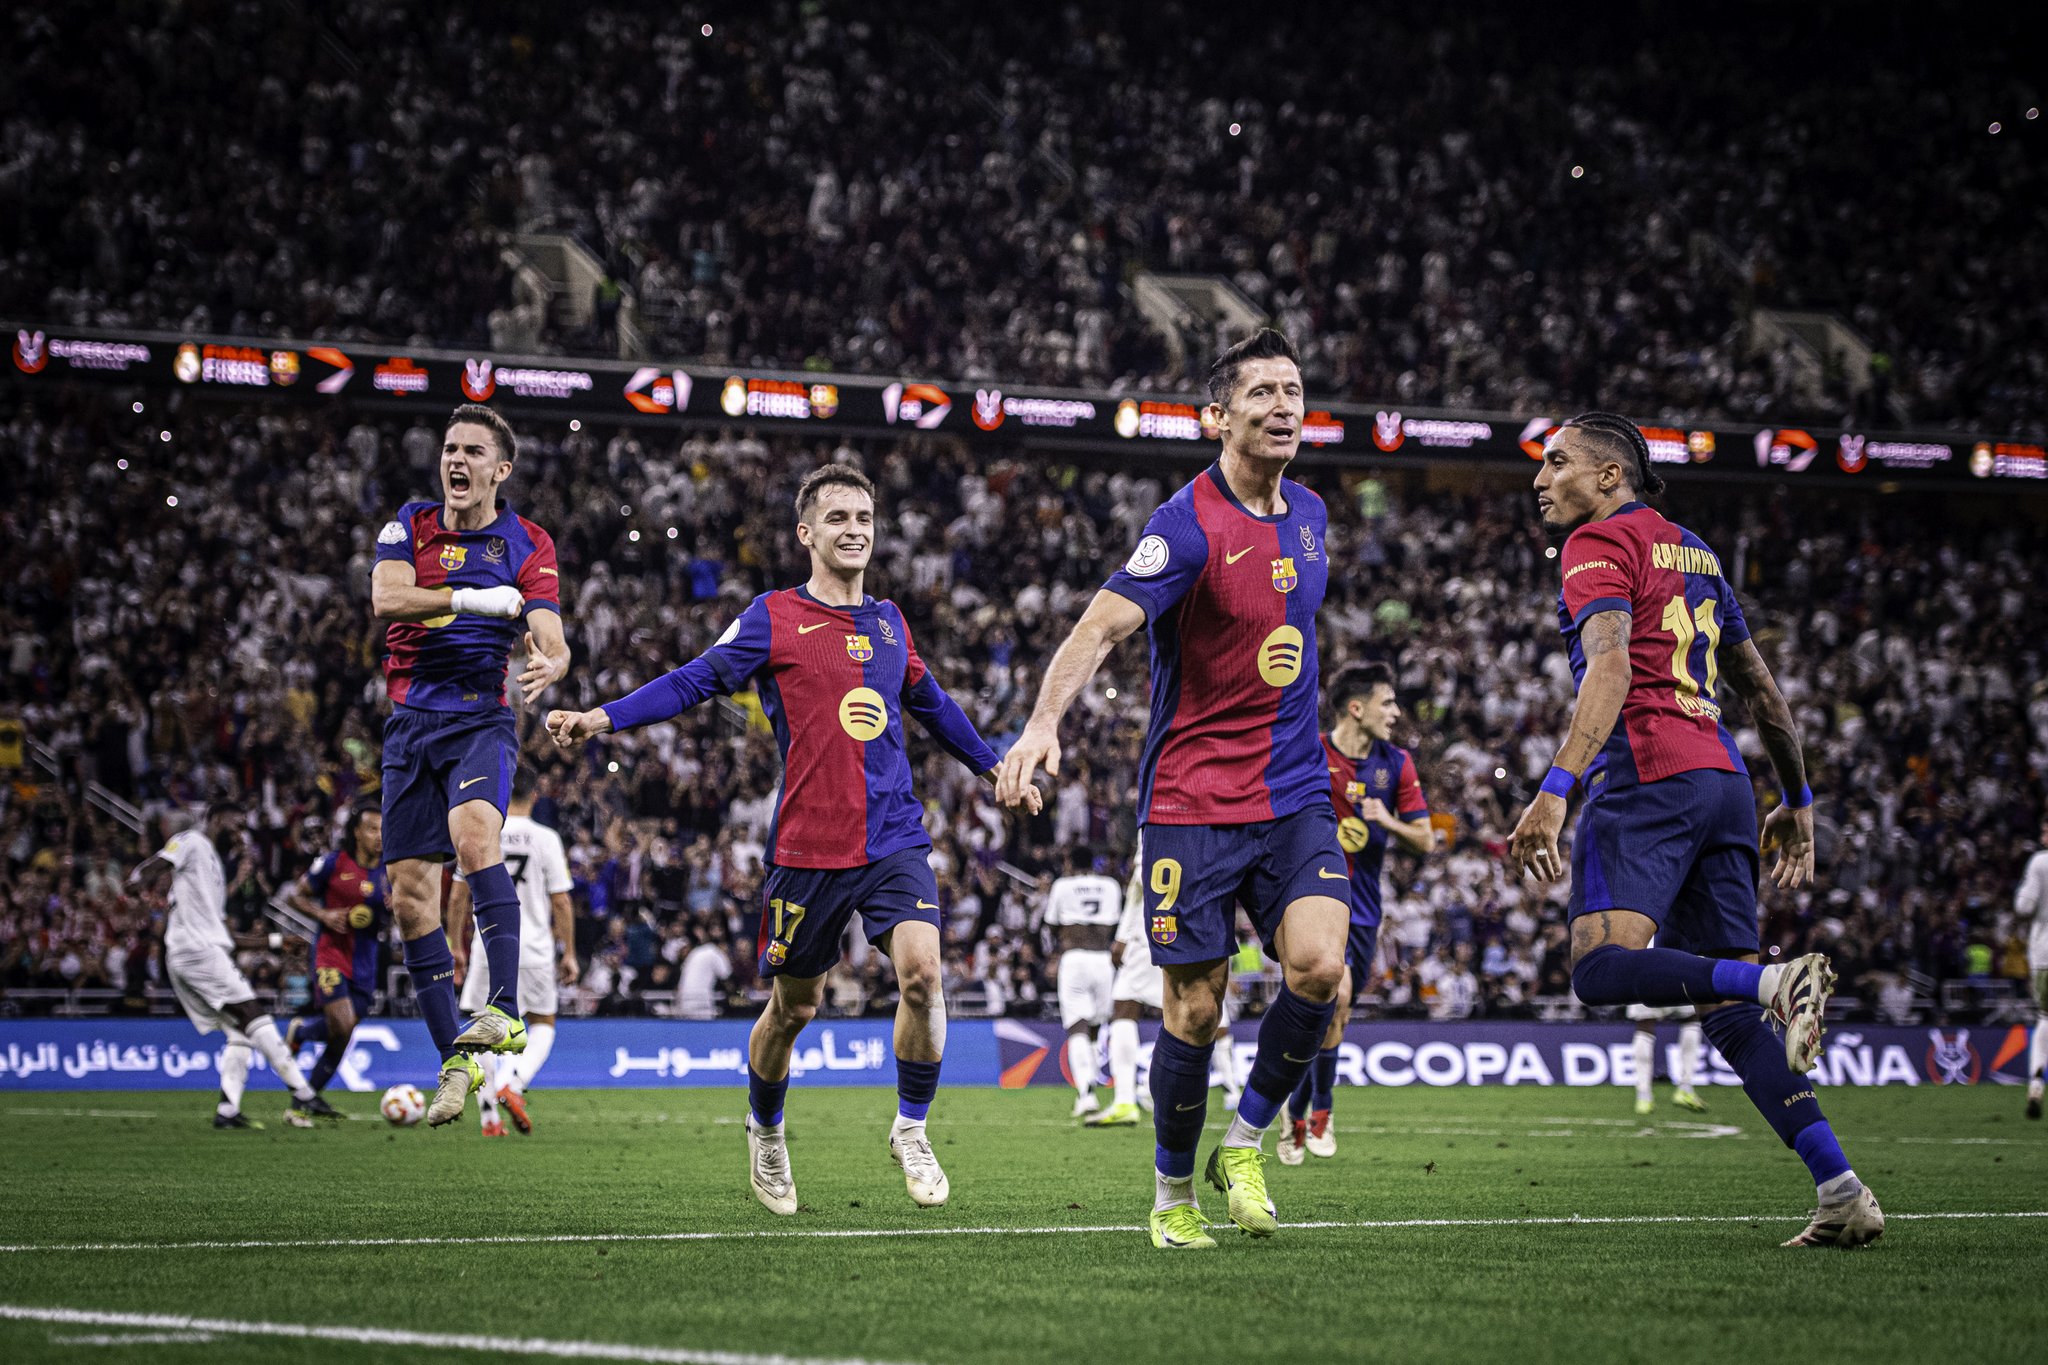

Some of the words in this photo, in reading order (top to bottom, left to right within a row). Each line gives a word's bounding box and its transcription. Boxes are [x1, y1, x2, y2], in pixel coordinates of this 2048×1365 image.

[1564, 561, 1608, 581] AMBILIGHT
[1652, 543, 1722, 577] RAPHINHA
[1661, 595, 1720, 698] 11
[1151, 858, 1182, 910] 9
[770, 898, 806, 943] 17
[1561, 1042, 1638, 1087] DE
[1665, 1032, 1921, 1087] ESAÑA
